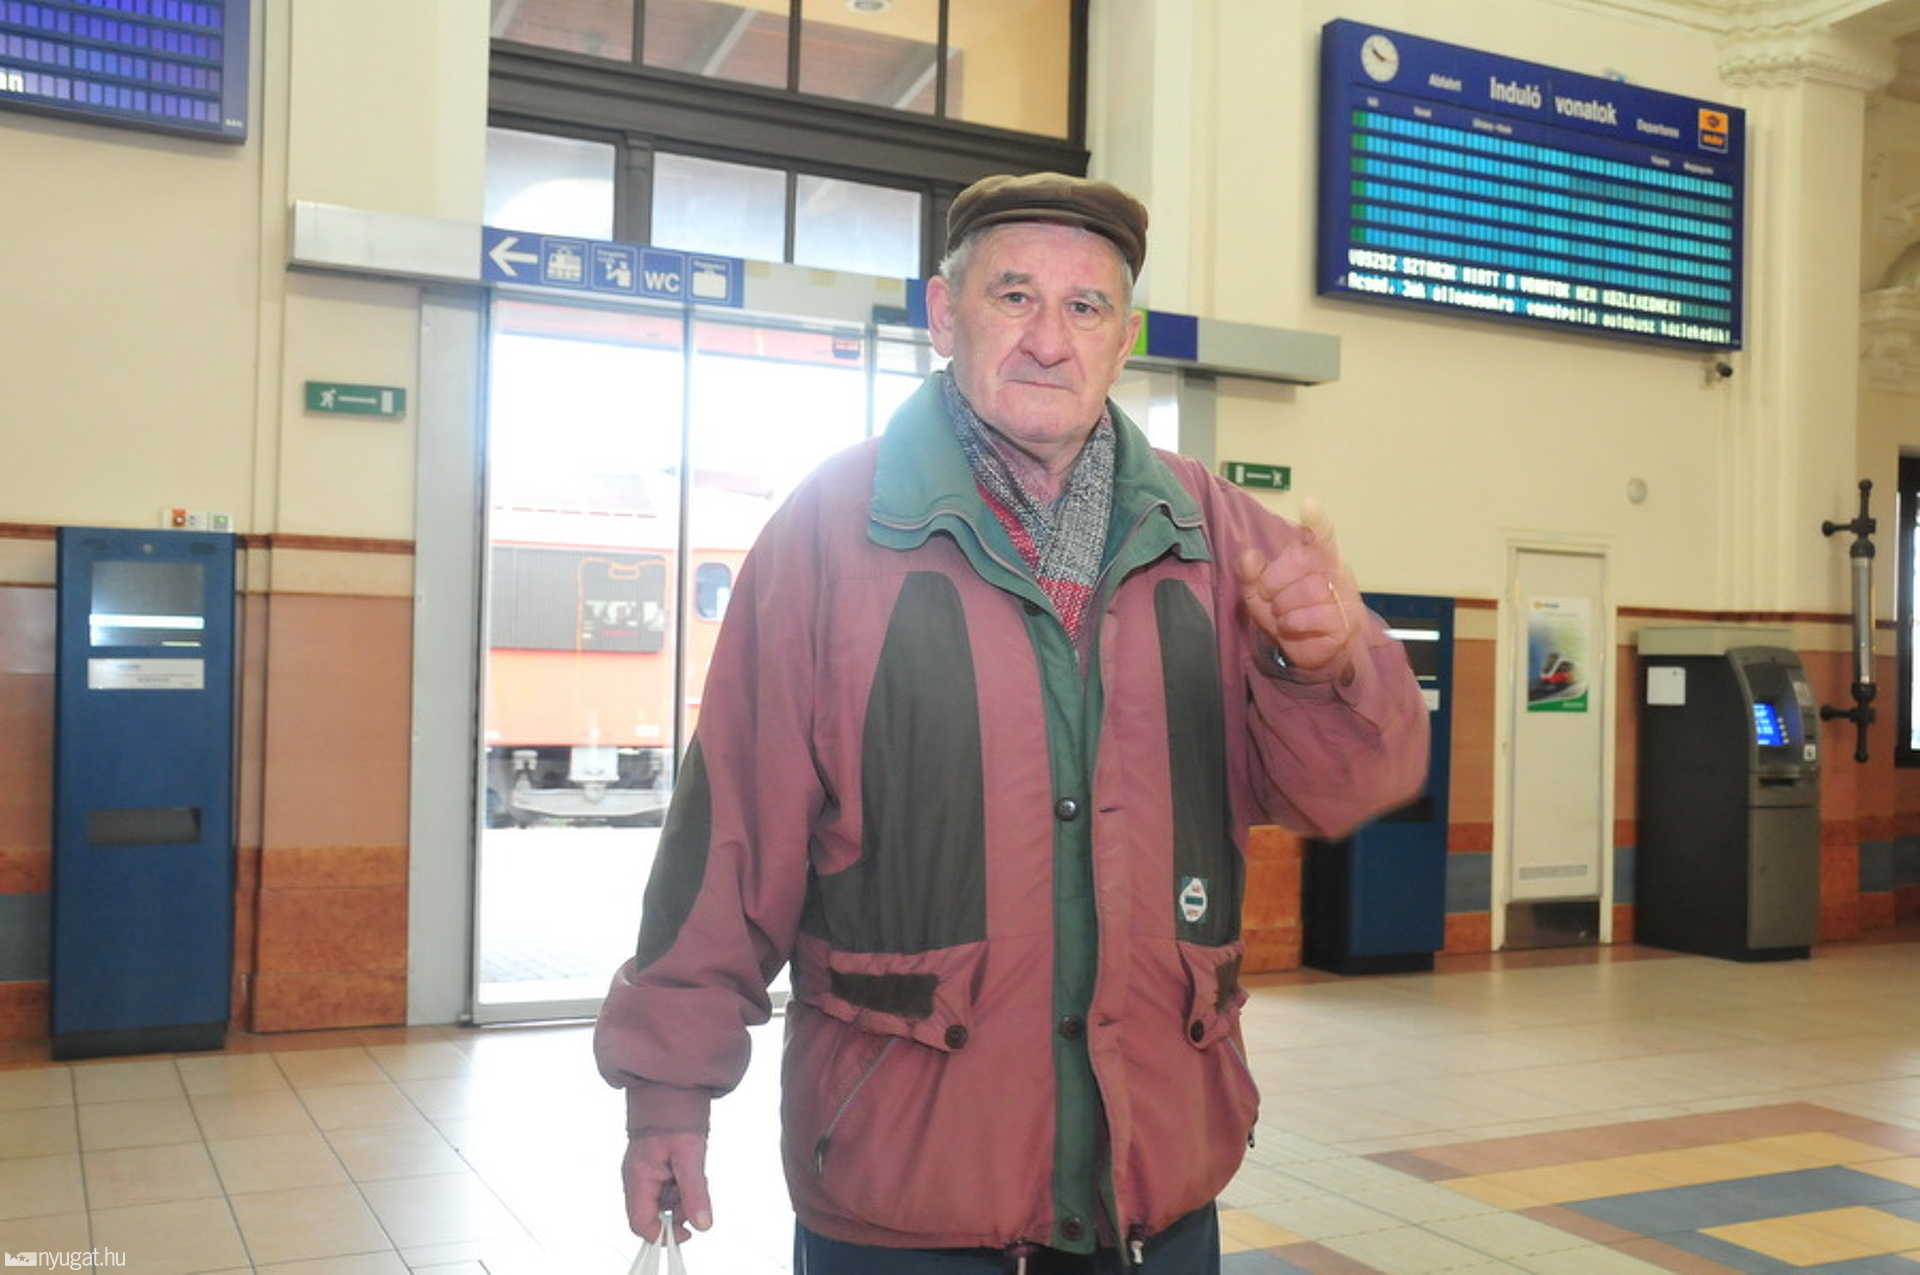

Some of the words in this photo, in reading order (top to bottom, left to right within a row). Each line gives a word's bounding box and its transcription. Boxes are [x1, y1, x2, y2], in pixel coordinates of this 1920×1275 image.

[1490, 76, 1541, 110] Induló
[1554, 95, 1618, 126] vonatok
[644, 271, 680, 292] WC
